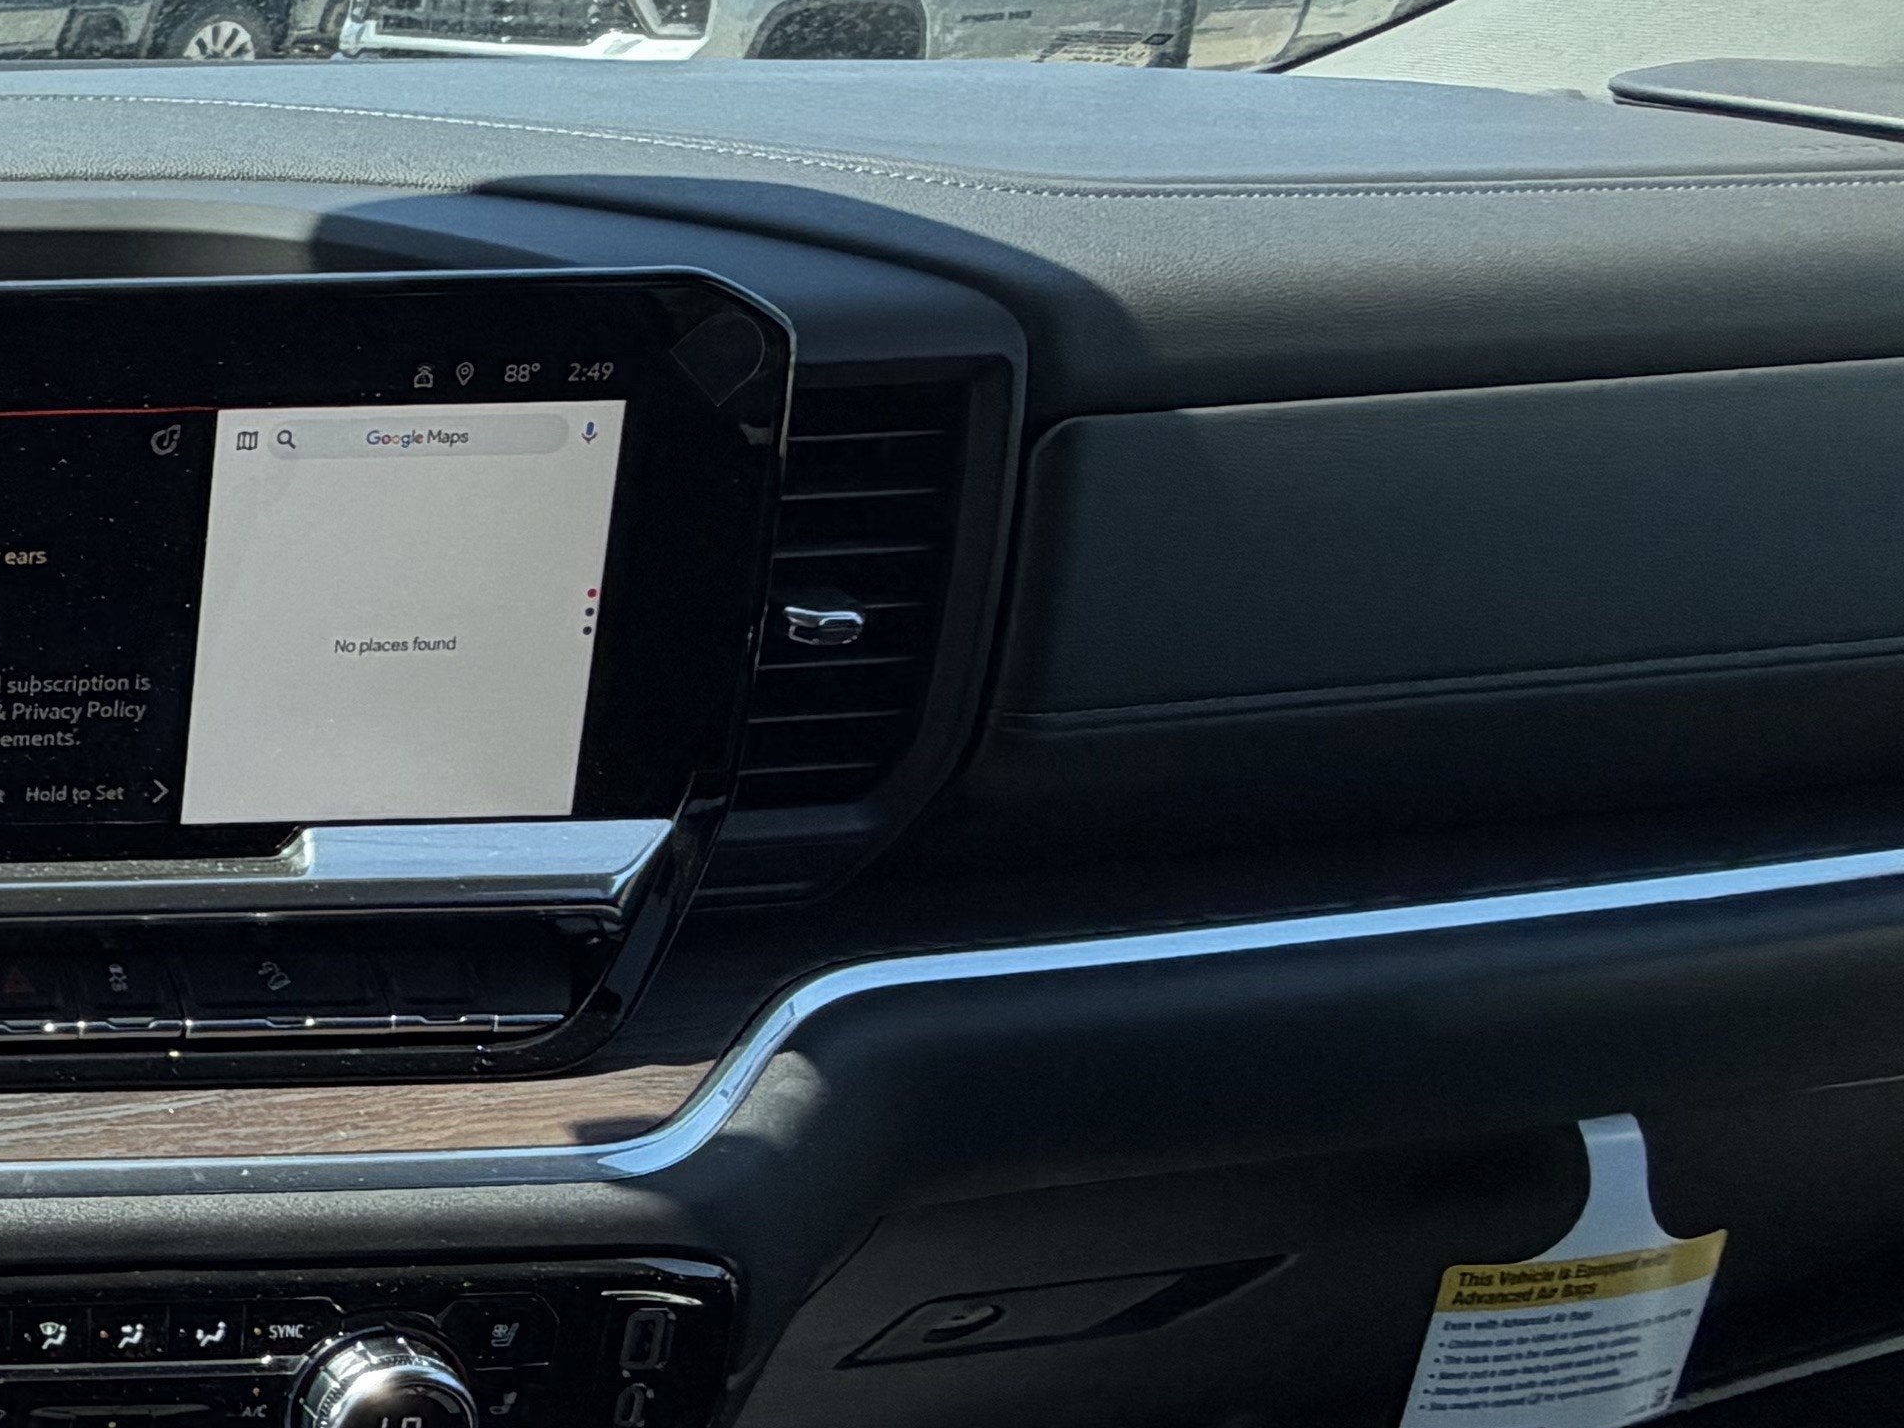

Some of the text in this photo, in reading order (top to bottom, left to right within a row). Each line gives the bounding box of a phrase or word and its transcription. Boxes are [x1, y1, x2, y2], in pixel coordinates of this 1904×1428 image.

[503, 362, 542, 383] 88°
[567, 361, 615, 382] 2:49
[365, 427, 470, 449] Google Maps
[4, 550, 48, 566] ears
[334, 636, 457, 656] No places found
[6, 674, 130, 697] subscription
[134, 673, 152, 692] is
[12, 702, 83, 724] Privacy
[87, 699, 147, 722] Policy
[25, 785, 125, 803] Hold to Set
[1458, 1271, 1494, 1288] This
[1451, 1285, 1533, 1306] Advanced
[268, 1324, 305, 1340] SYNC
[242, 1404, 268, 1419] A/C
